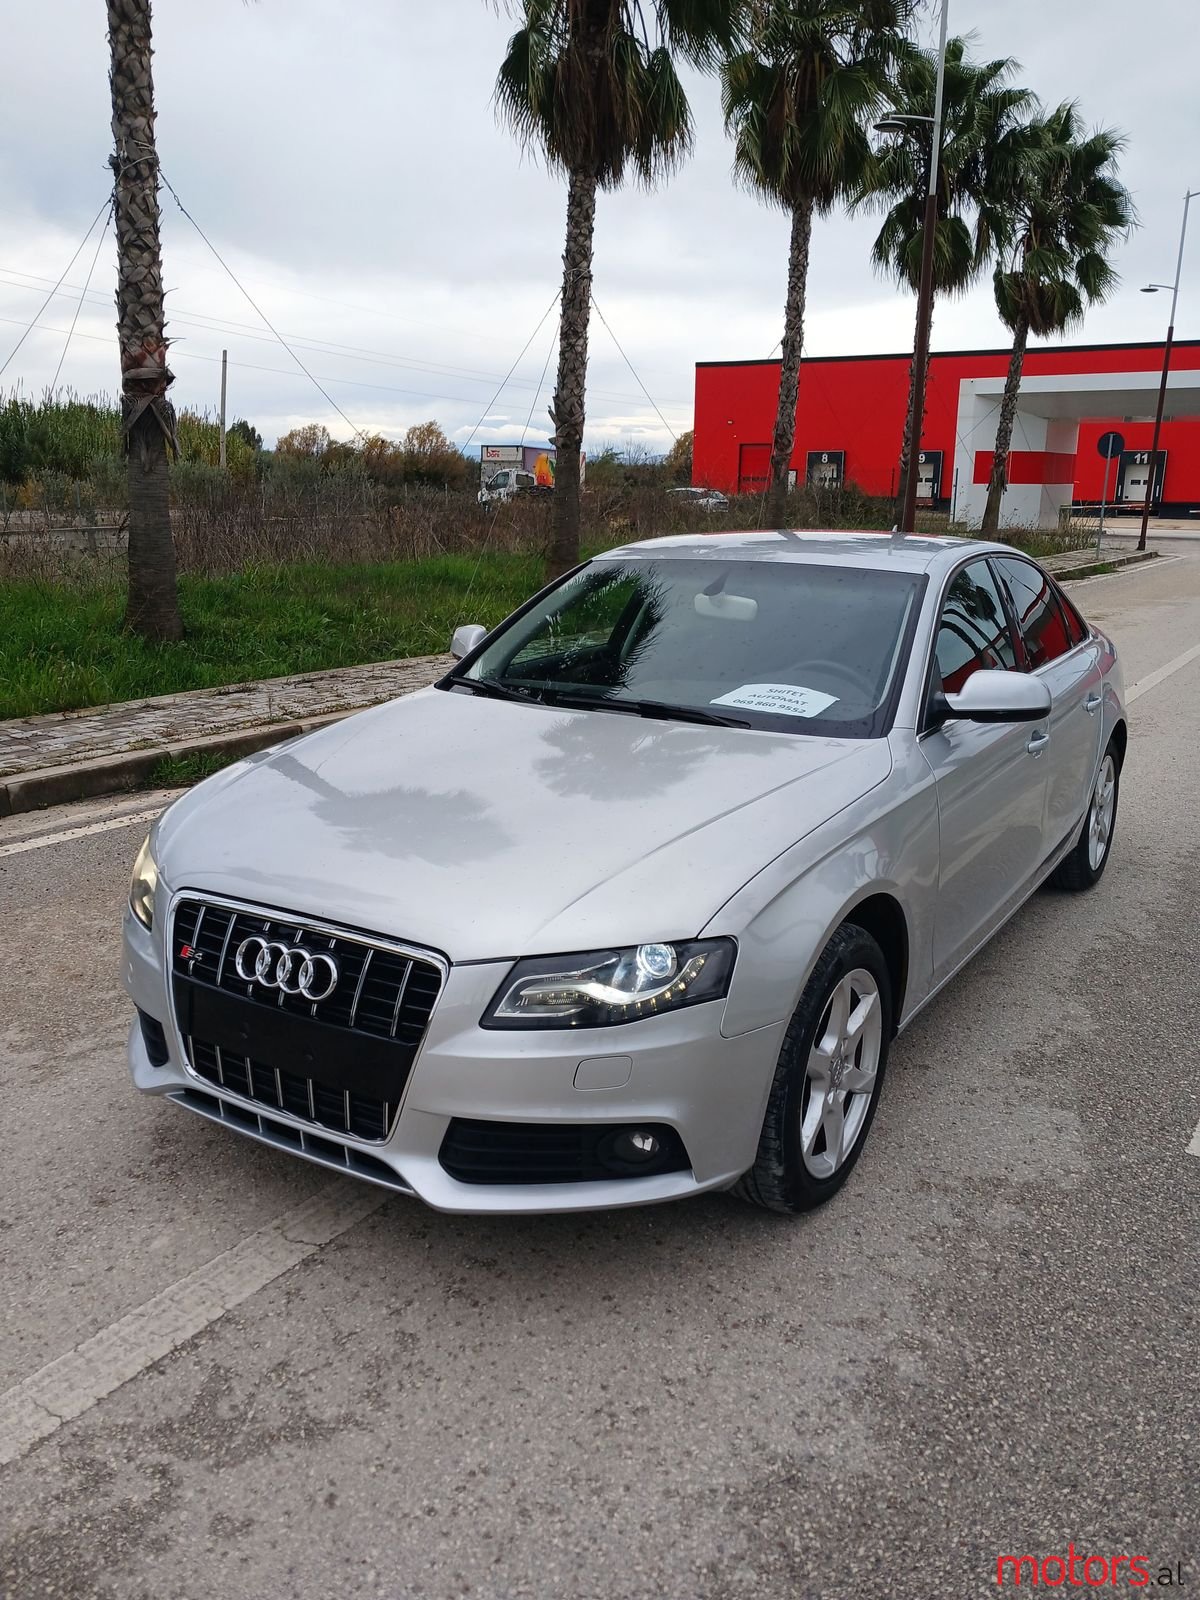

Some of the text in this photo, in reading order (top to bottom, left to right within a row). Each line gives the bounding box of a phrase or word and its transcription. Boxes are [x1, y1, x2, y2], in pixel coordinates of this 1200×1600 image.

[821, 453, 829, 463] 8
[918, 453, 926, 463] 9
[1134, 453, 1149, 464] 11
[767, 688, 807, 698] SHITET
[748, 693, 809, 706] AUTOMAT
